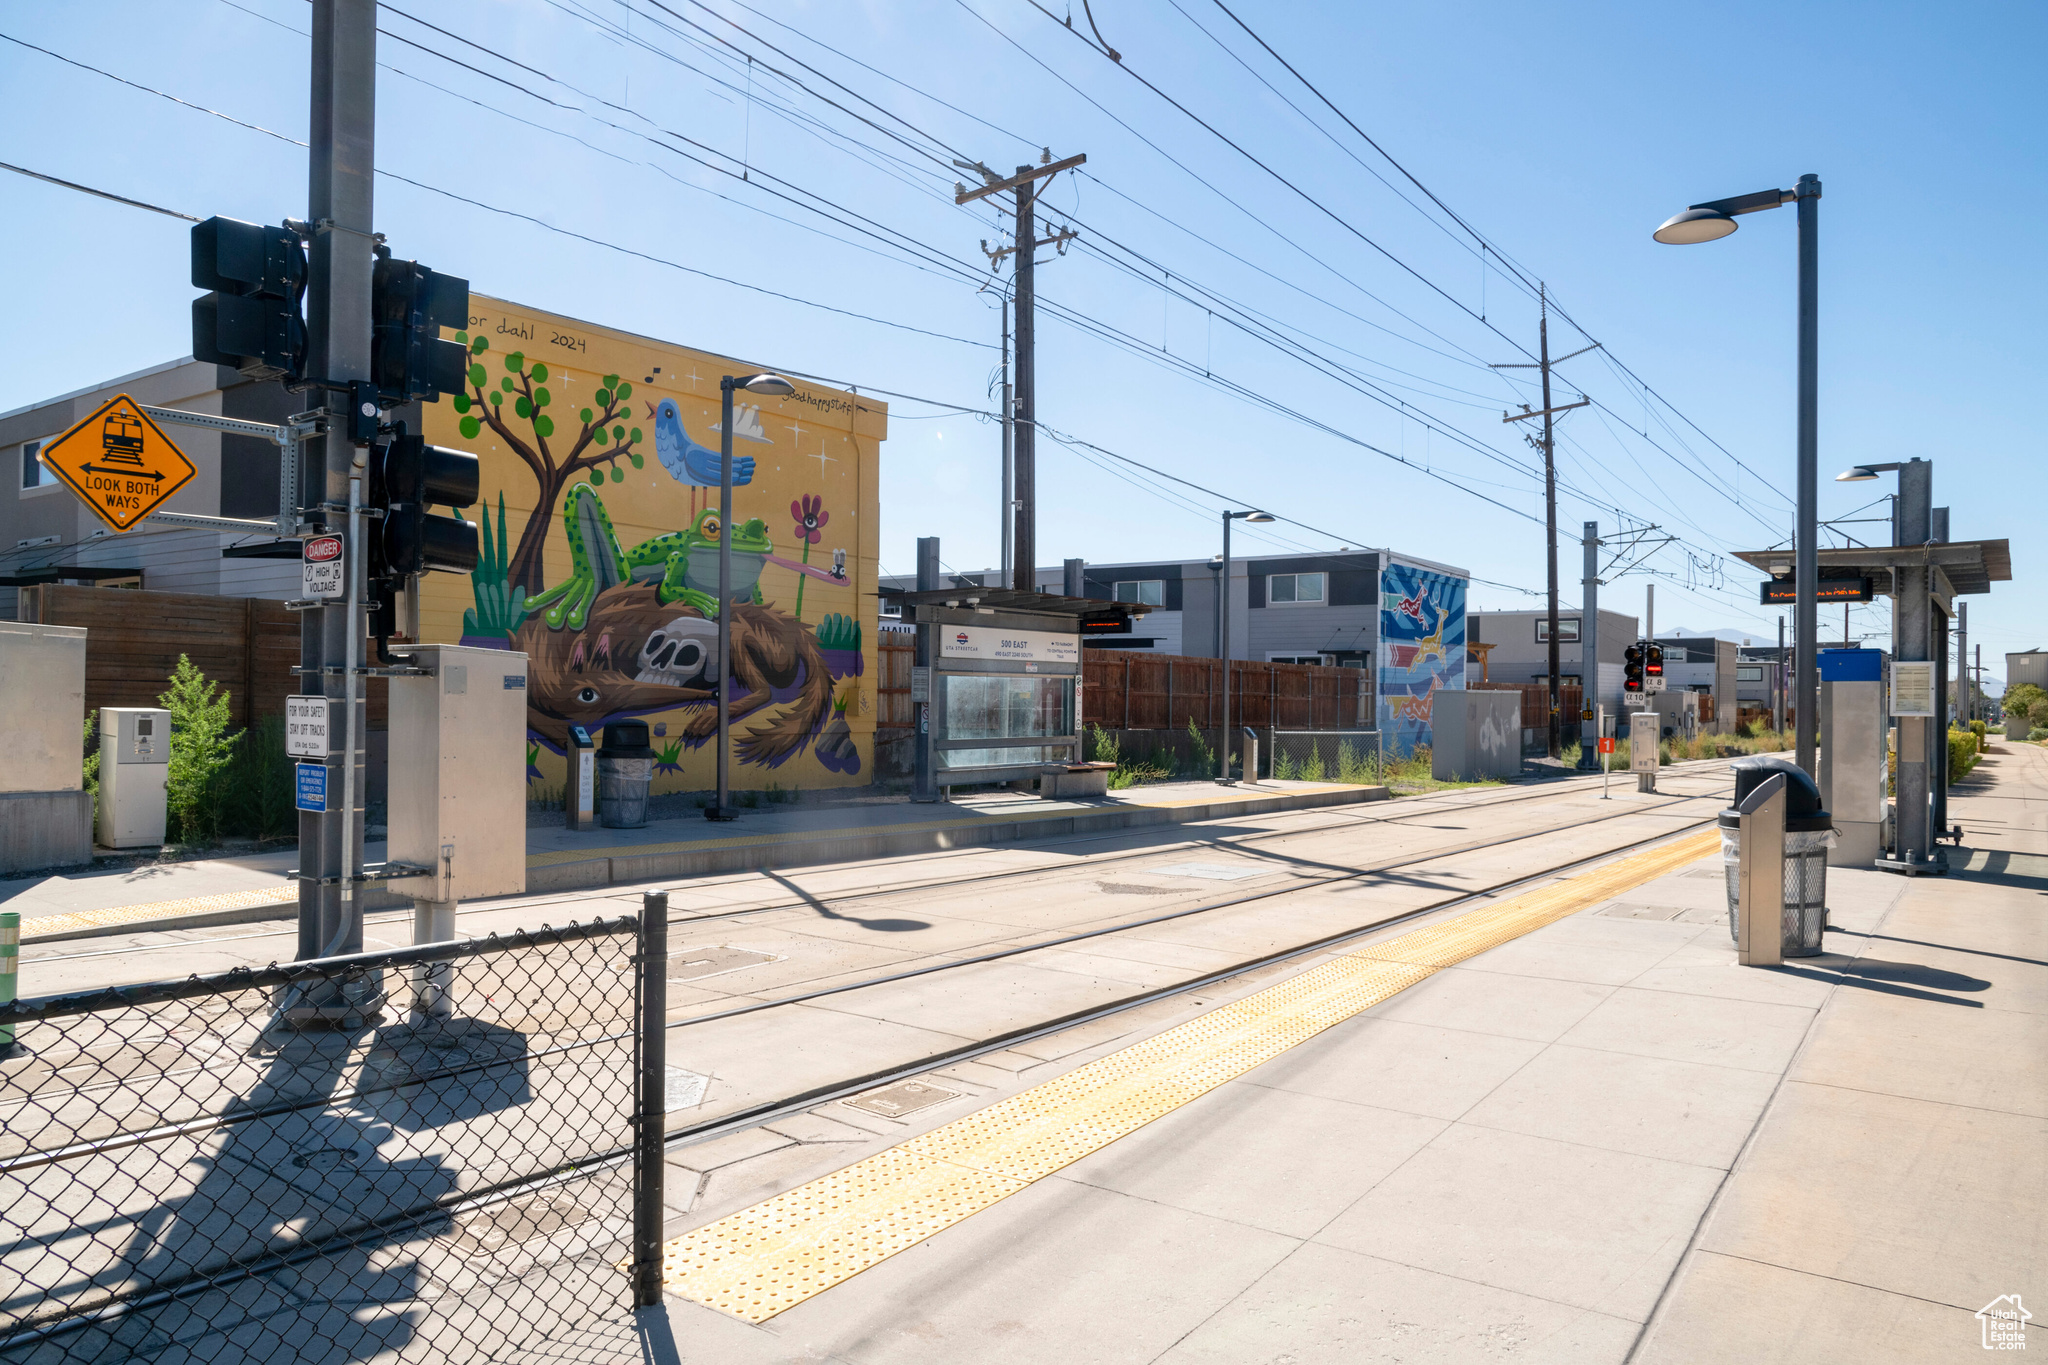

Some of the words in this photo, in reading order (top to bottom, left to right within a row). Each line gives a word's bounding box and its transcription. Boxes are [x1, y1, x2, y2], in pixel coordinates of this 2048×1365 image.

[496, 317, 534, 340] dahl
[550, 331, 586, 354] 2024
[781, 391, 852, 416] goodhappystuff
[85, 476, 121, 492] LOOK
[126, 481, 160, 496] BOTH
[105, 494, 140, 509] WAYS
[309, 541, 338, 558] DANGER
[315, 566, 330, 578] HIGH
[309, 580, 336, 593] VOLTAGE
[1001, 640, 1012, 648] 500
[1013, 641, 1028, 649] EAST
[289, 705, 297, 717] FOR
[298, 705, 309, 717] YOUR
[310, 705, 325, 718] SAFETY
[289, 723, 299, 735] STAY
[300, 723, 308, 736] OFF
[309, 724, 325, 737] TRACKS
[1604, 739, 1610, 751] 1
[298, 768, 310, 776] REPORT
[306, 777, 322, 785] EMERGENCY
